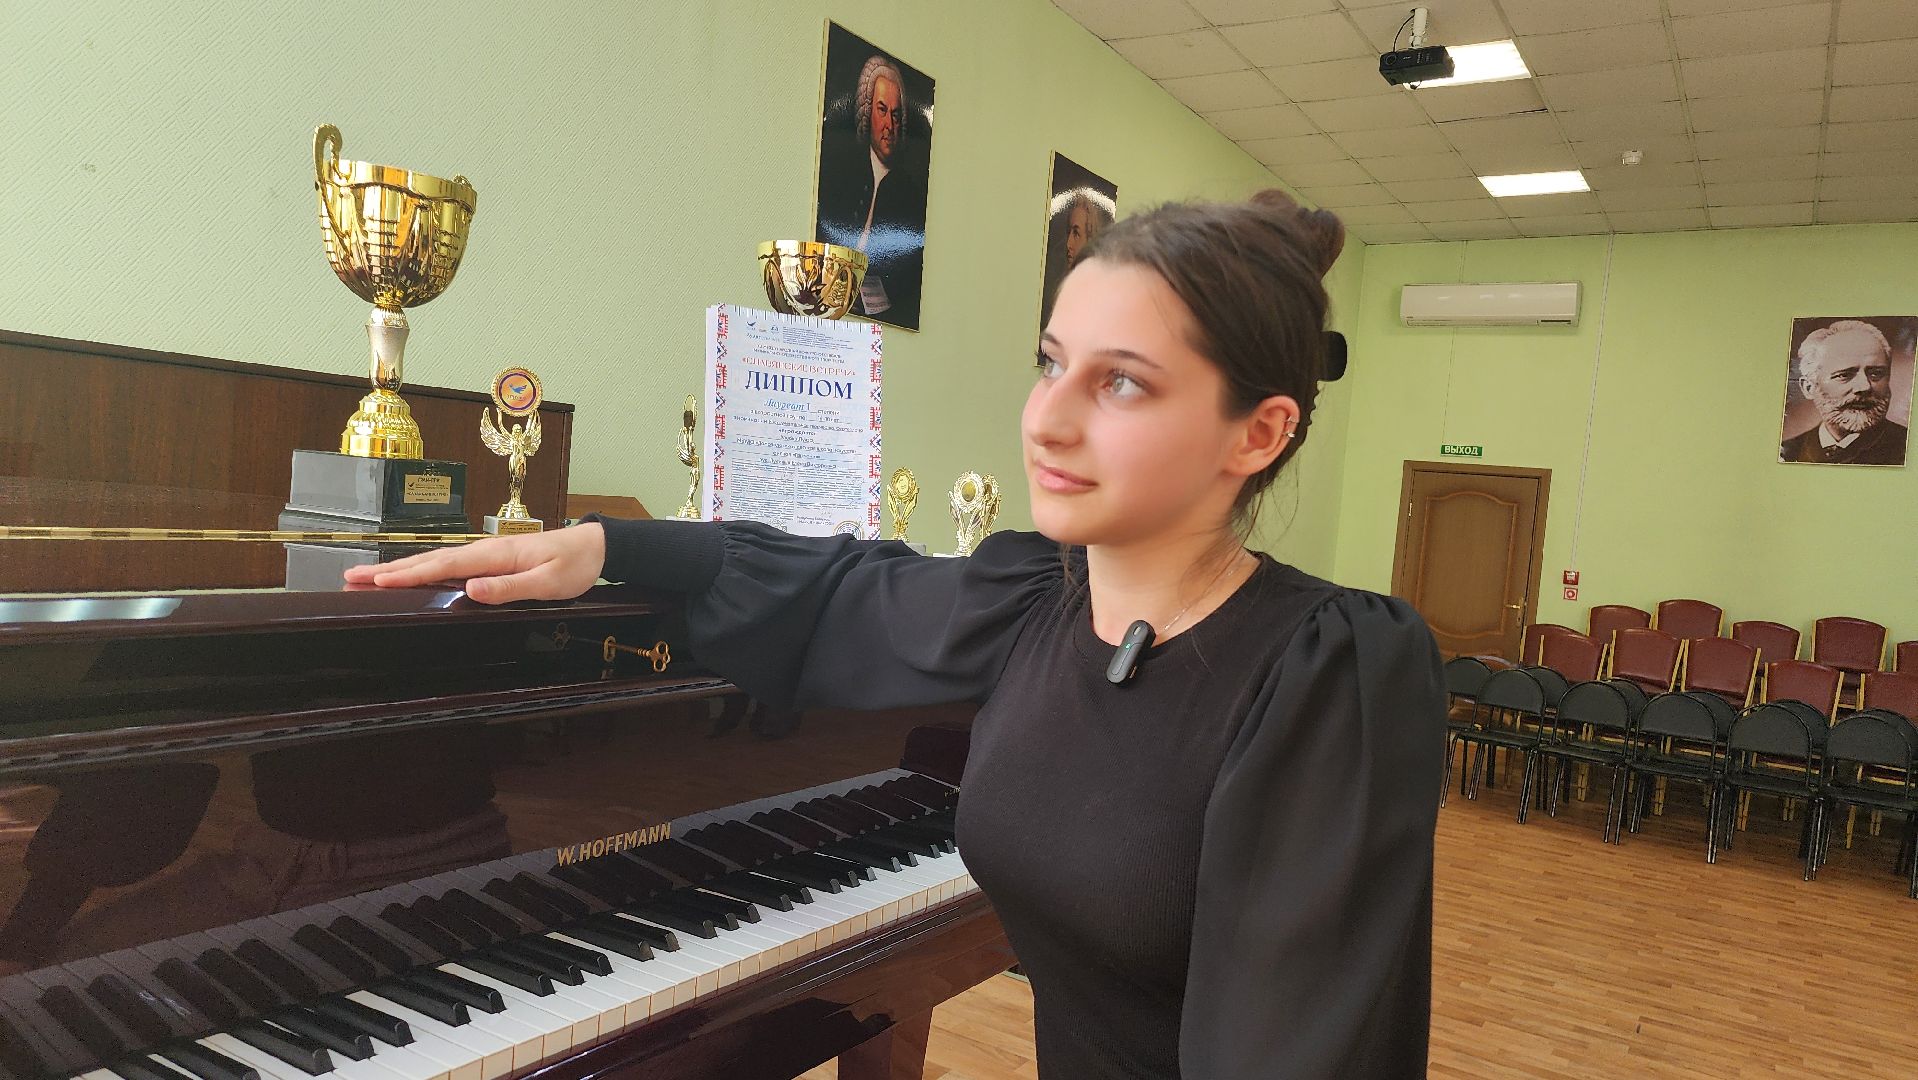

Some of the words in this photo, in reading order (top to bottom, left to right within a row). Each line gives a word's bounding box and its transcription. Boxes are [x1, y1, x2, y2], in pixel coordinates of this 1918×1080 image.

[745, 370, 853, 399] ДИПЛОМ
[1444, 445, 1479, 456] ВЫХОД
[557, 822, 672, 867] W.HOFFMANN
